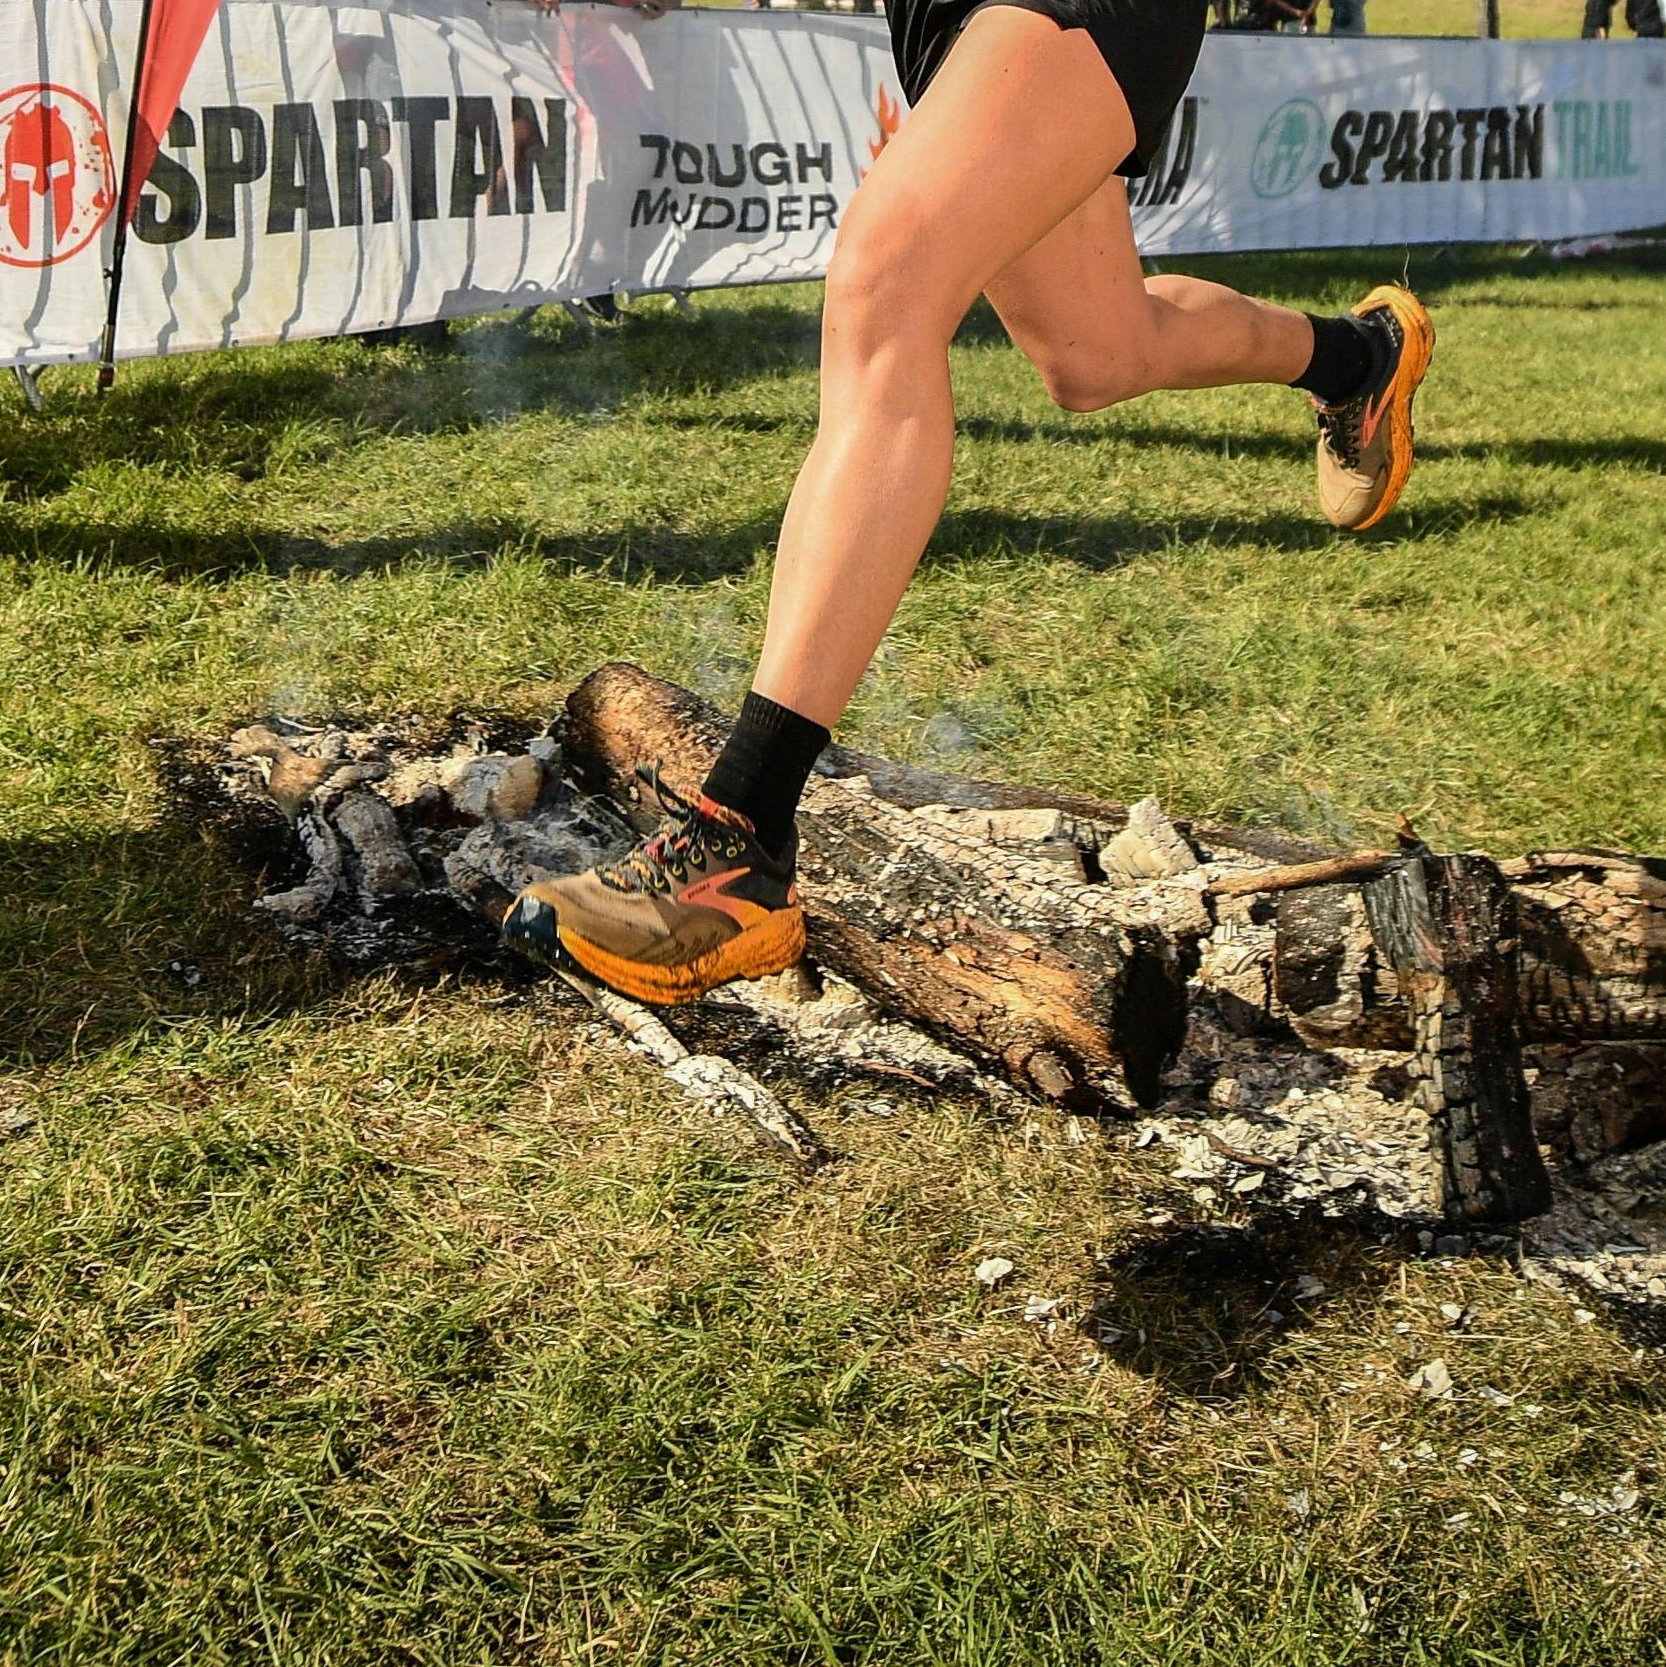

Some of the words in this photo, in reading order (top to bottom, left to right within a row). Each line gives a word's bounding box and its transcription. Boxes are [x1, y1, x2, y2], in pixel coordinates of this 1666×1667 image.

[133, 96, 567, 244] SPARTAN
[639, 134, 832, 188] TOUGH
[1319, 103, 1546, 190] SPARTAN
[1553, 100, 1640, 180] TRAIL
[631, 187, 838, 233] MUDDER
